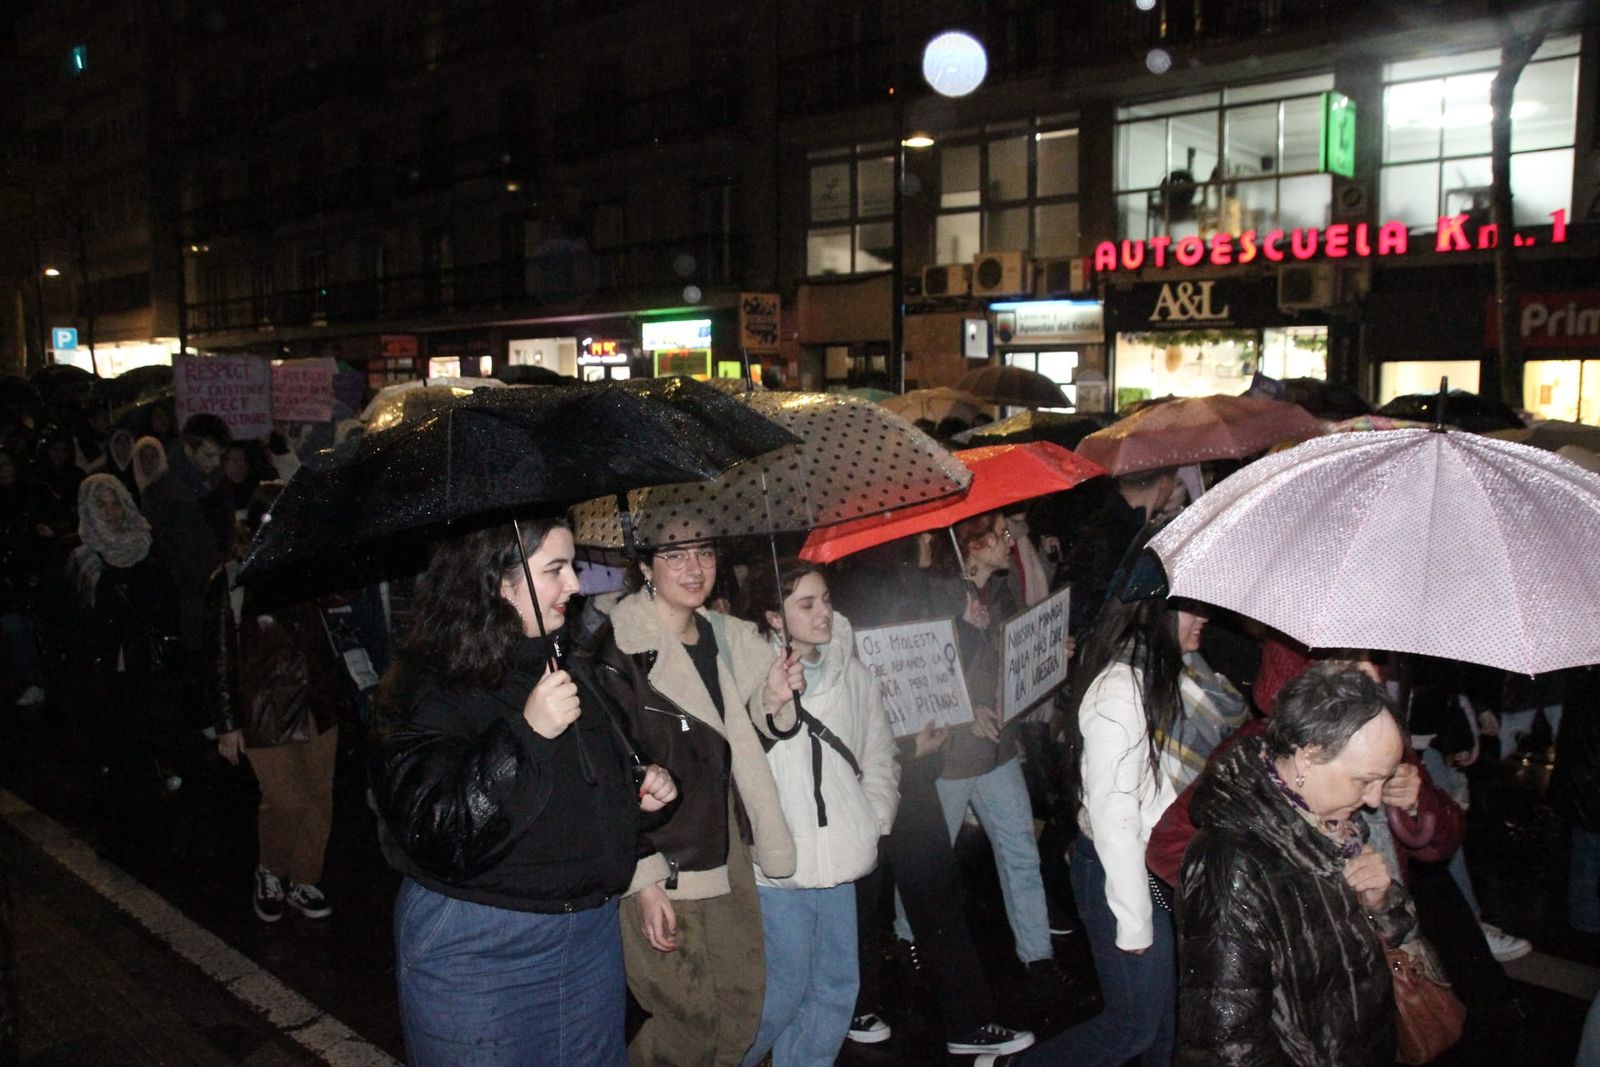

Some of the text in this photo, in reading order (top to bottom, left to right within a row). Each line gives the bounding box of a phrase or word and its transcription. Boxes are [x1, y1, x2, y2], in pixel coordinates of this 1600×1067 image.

[1095, 221, 1408, 272] AUTOESCUELA
[1548, 208, 1567, 243] 1
[1148, 281, 1229, 321] A&L
[57, 331, 72, 347] P
[185, 361, 249, 382] RESPECT
[186, 397, 249, 412] EXPECT
[1008, 602, 1064, 649] NUESTRA MANADA
[889, 631, 938, 650] MOLESTA
[1049, 626, 1062, 648] QUE
[908, 675, 929, 691] PERO
[937, 673, 949, 684] NO
[1015, 655, 1060, 702] LA VUESTRA
[915, 692, 959, 714] PIERNAS
